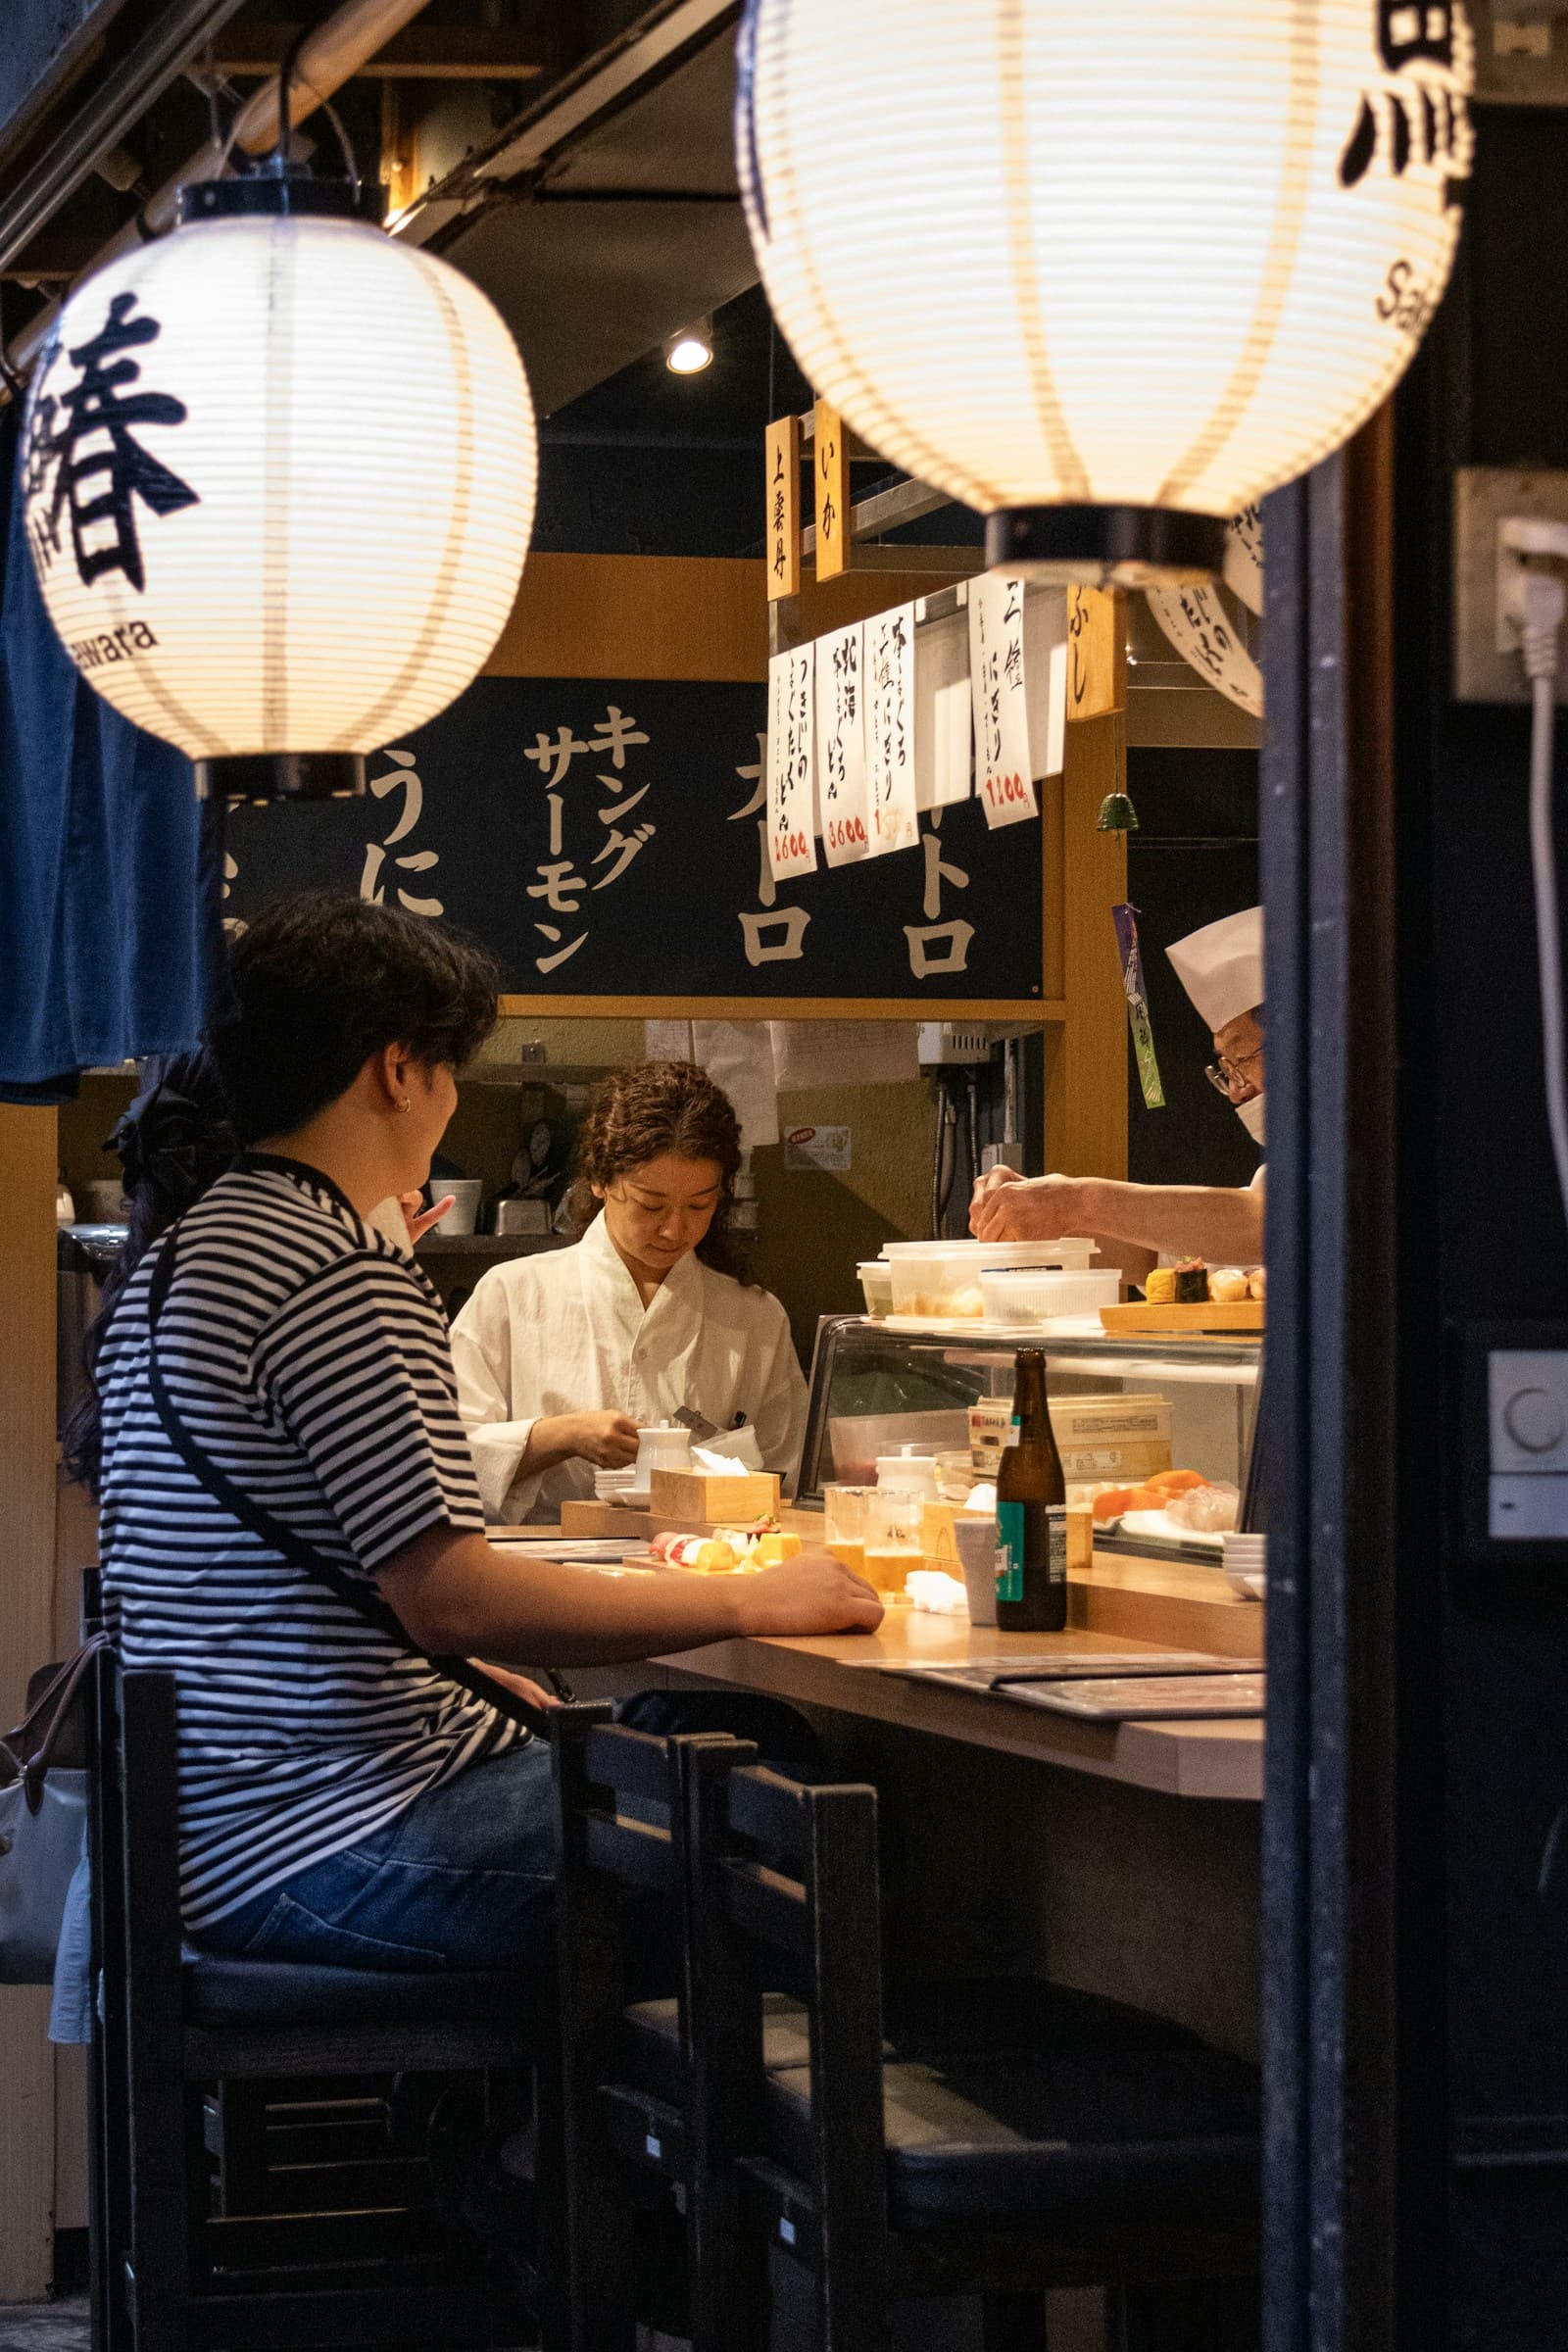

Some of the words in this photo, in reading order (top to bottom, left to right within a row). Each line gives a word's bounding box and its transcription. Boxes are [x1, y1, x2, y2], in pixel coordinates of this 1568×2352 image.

[821, 441, 836, 541] いか
[361, 749, 446, 918] うに
[523, 726, 590, 974] サーモン
[587, 705, 657, 892] キング
[902, 808, 976, 980] トロ
